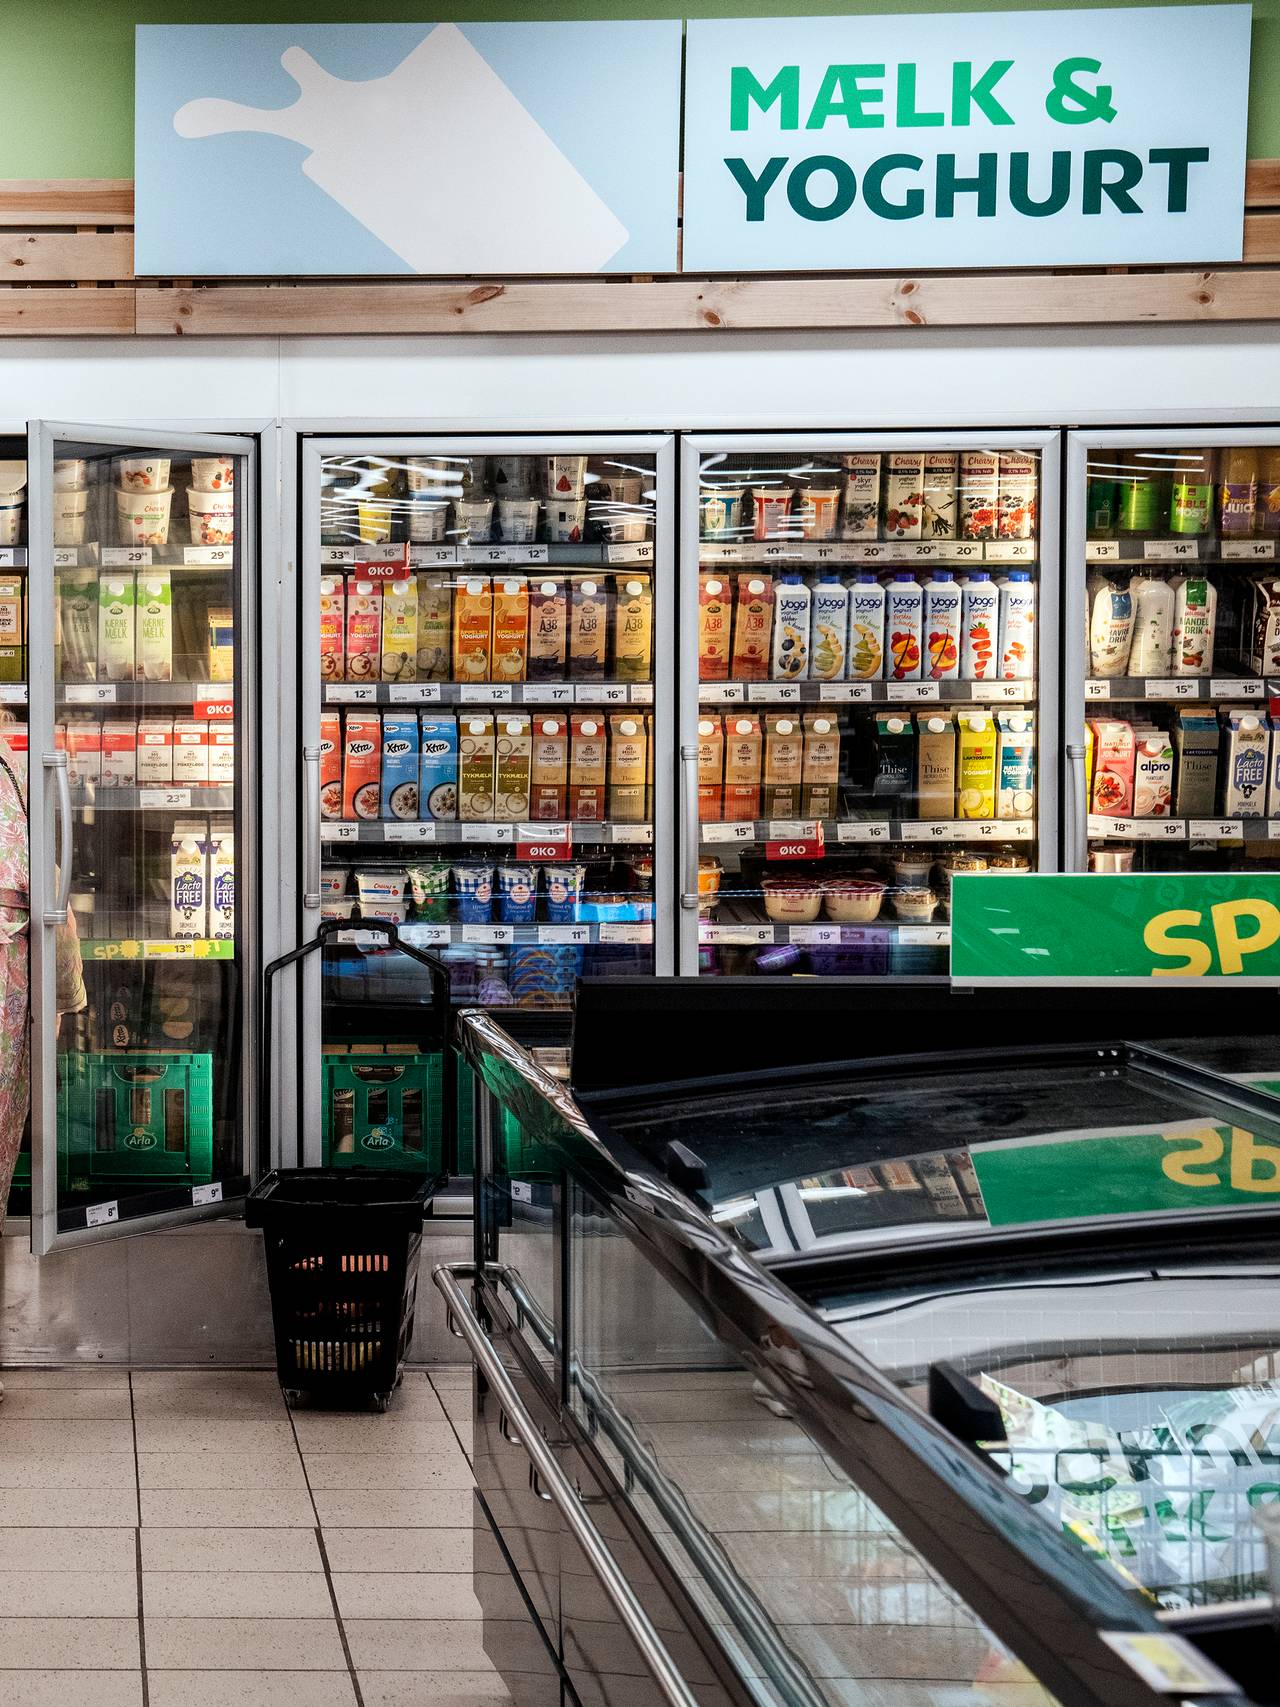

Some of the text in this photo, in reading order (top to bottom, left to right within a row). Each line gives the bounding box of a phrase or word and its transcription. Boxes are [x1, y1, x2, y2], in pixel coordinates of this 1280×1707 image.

[731, 57, 1118, 131] MÆLK &
[725, 147, 1210, 222] YOGHURT
[367, 566, 394, 576] ØKO
[206, 705, 233, 715] ØKO
[349, 742, 374, 754] Xtra
[387, 742, 410, 754] Xtra
[425, 742, 449, 754] Xtra
[922, 764, 949, 774] Thise
[1140, 761, 1170, 774] alpro
[1236, 757, 1263, 769] Lacto
[1236, 768, 1262, 781] FREE
[529, 846, 556, 857] ØKO
[779, 845, 806, 855] ØKO
[176, 881, 201, 891] Lacto
[176, 891, 201, 904] FREE
[128, 1135, 151, 1146] Arla
[365, 1135, 389, 1146] Arla
